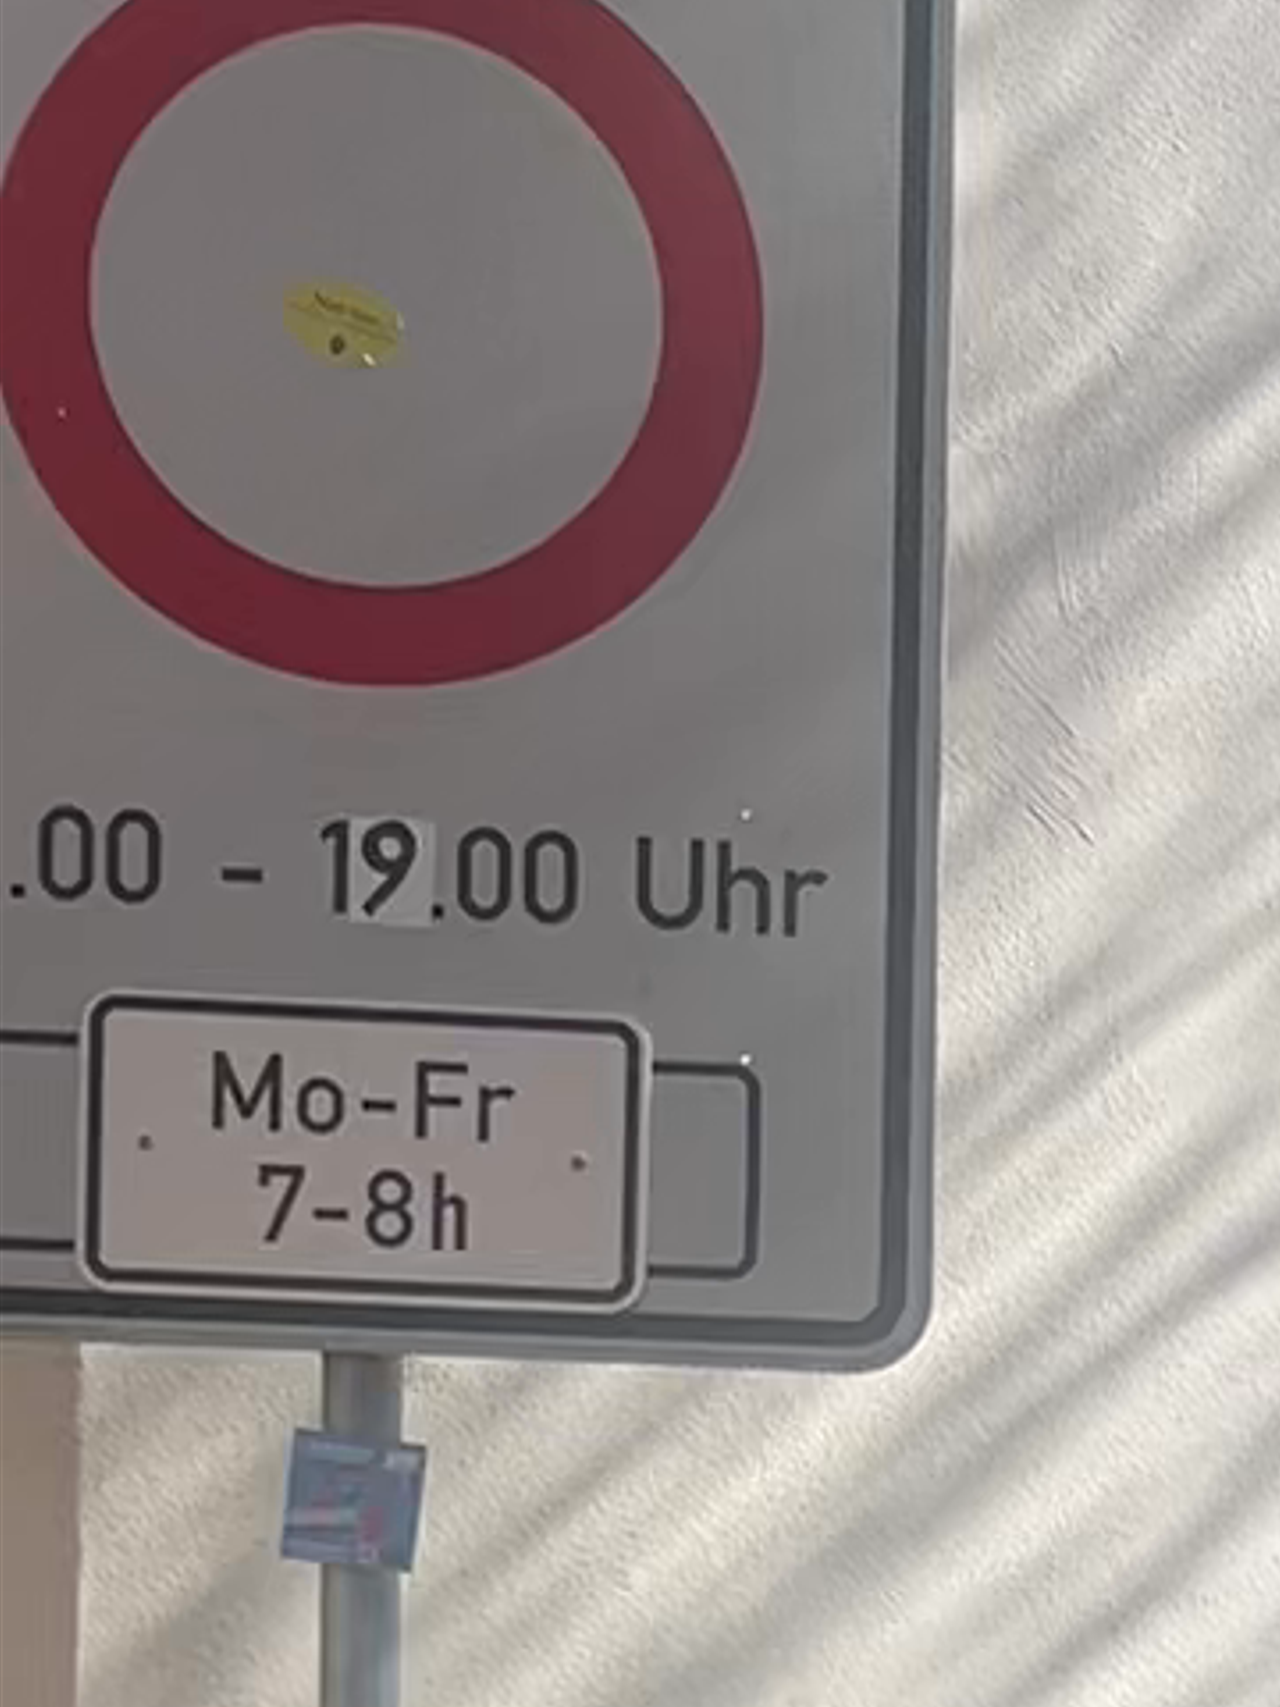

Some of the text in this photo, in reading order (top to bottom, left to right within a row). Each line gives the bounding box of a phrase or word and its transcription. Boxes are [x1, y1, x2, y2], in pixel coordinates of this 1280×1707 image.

[319, 817, 580, 925] 19.00
[635, 835, 829, 938] Uhr
[211, 1049, 517, 1143] Mo-Fr
[257, 1164, 468, 1251] 7-8h
